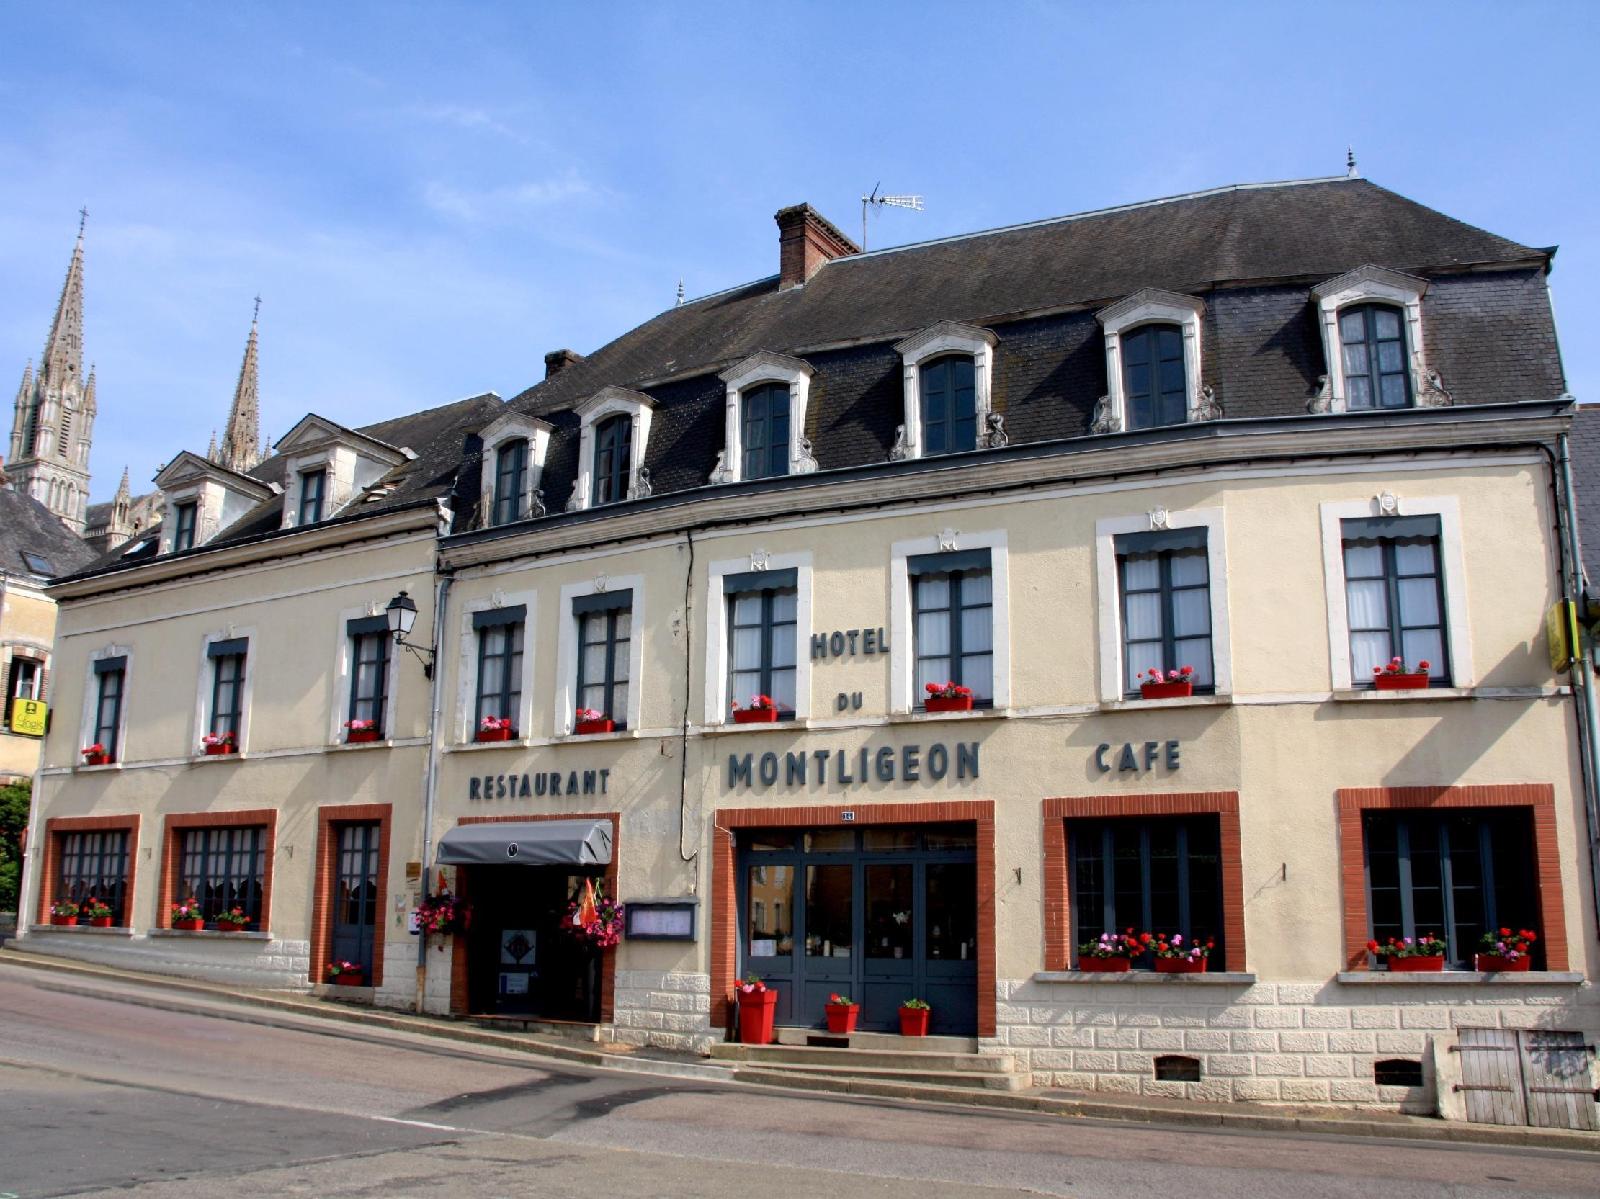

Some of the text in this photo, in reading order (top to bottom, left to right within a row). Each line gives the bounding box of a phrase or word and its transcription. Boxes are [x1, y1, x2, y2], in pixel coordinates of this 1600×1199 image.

[811, 628, 889, 660] HOTEL
[838, 692, 863, 711] DU
[728, 742, 980, 788] MONTLIGEON
[1095, 740, 1180, 773] CAFE
[470, 769, 610, 800] RESTAURANT
